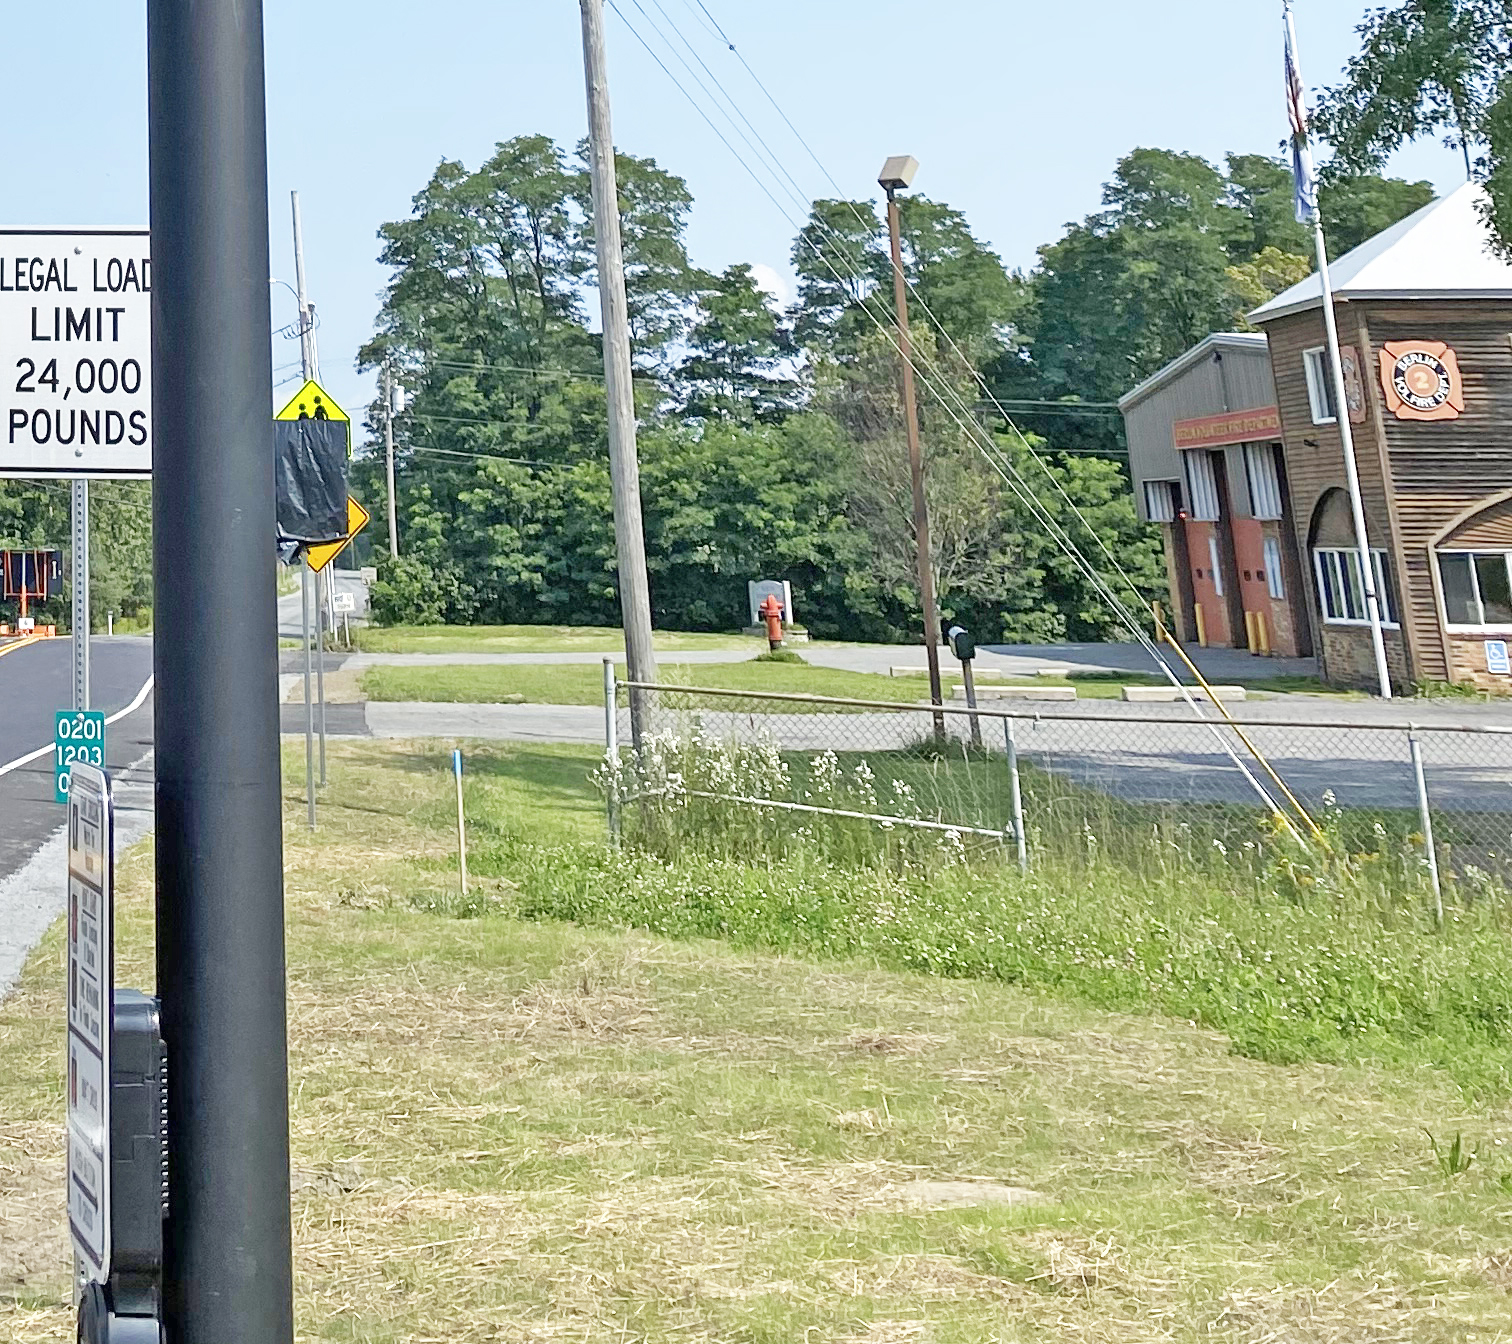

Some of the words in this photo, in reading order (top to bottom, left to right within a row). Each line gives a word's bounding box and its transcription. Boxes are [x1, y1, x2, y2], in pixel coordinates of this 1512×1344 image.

[0, 257, 78, 292] LEGAL
[31, 306, 126, 342] LIMIT
[1397, 353, 1439, 371] BERLIN
[15, 358, 142, 401] 24,000
[1413, 371, 1430, 389] 2
[1410, 393, 1437, 408] FIRE
[8, 409, 149, 445] POUNDS
[58, 718, 102, 740] 0201
[57, 745, 102, 767] 1203
